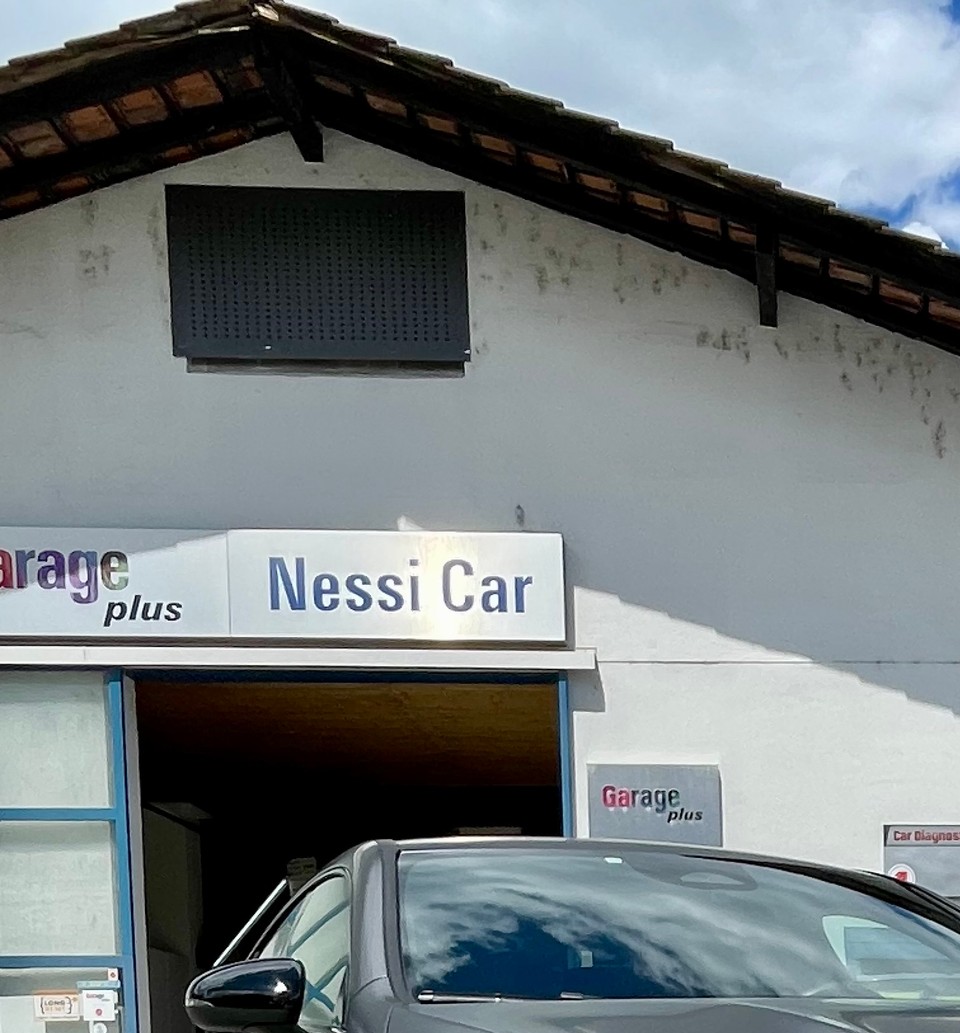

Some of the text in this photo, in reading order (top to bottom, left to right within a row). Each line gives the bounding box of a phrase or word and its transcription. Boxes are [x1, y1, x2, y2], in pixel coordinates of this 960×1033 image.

[0, 549, 129, 604] arage
[268, 557, 533, 613] Nessi Car
[103, 595, 182, 627] plus
[602, 785, 680, 814] Garage
[667, 808, 703, 823] plus
[893, 830, 912, 841] Car
